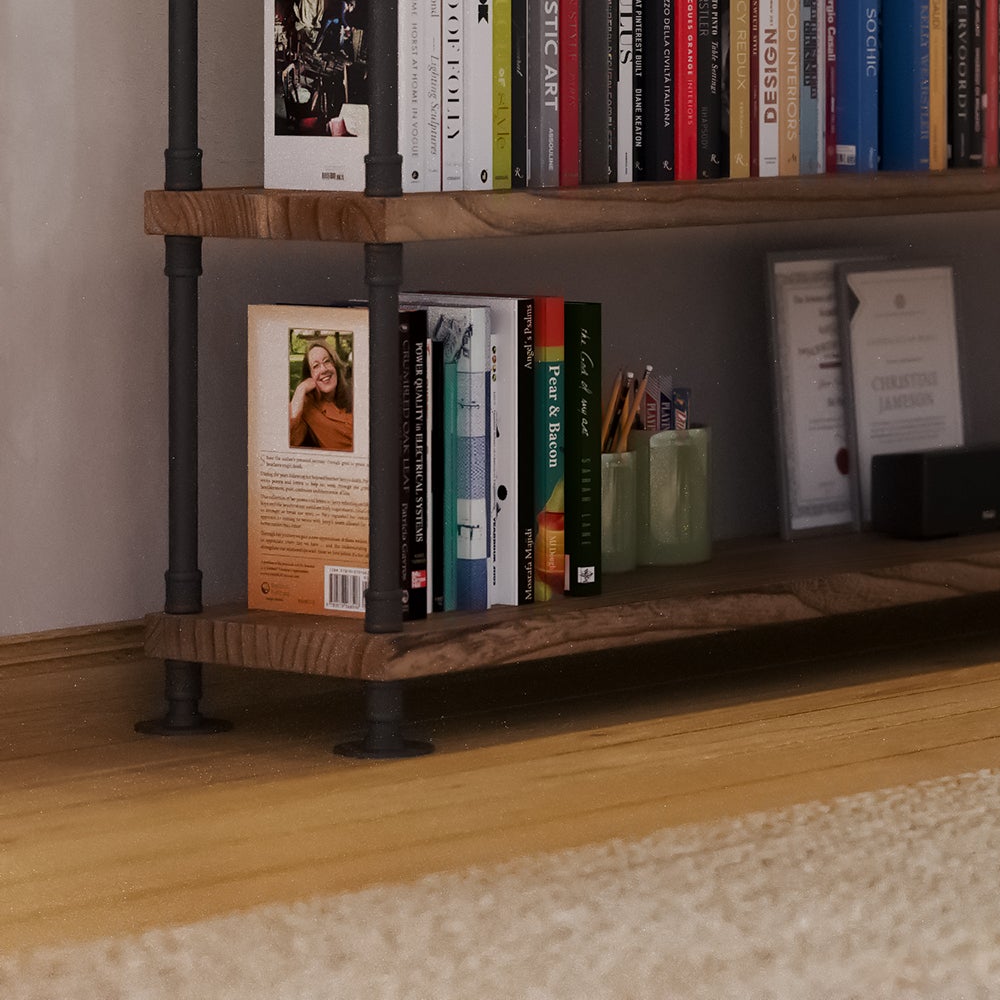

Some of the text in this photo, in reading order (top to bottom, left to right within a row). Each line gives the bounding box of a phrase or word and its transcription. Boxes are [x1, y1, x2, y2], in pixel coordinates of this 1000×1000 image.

[410, 23, 419, 55] HORST
[447, 16, 460, 52] OF
[568, 10, 578, 63] STYLE
[663, 18, 671, 47] DELLA
[711, 41, 719, 63] Table
[866, 8, 877, 78] SO CHIC
[410, 59, 419, 70] AT
[428, 56, 440, 99] Lighting
[711, 64, 719, 95] Settings
[736, 30, 747, 90] REDUX
[764, 28, 777, 124] DESIGN
[410, 74, 419, 104] HOME
[544, 65, 558, 111] ART
[663, 86, 671, 128] ITALIANA
[786, 47, 797, 141] INTERIORS
[410, 108, 419, 119] IN
[428, 102, 440, 156] Sculptures
[700, 106, 709, 150] RHAPSODY
[410, 123, 419, 158] VOGUE
[523, 304, 532, 334] Psalms
[402, 340, 410, 419] CRUMBLED
[579, 381, 593, 395] of
[402, 421, 410, 453] OAK
[549, 365, 561, 468] Pear & Bacon
[413, 342, 424, 542] POWER QUALITY in ELECTRICAL SYSTEMS
[402, 458, 410, 496] LEAF
[581, 456, 591, 503] SARAH
[523, 528, 534, 601] Mostafa Majidi
